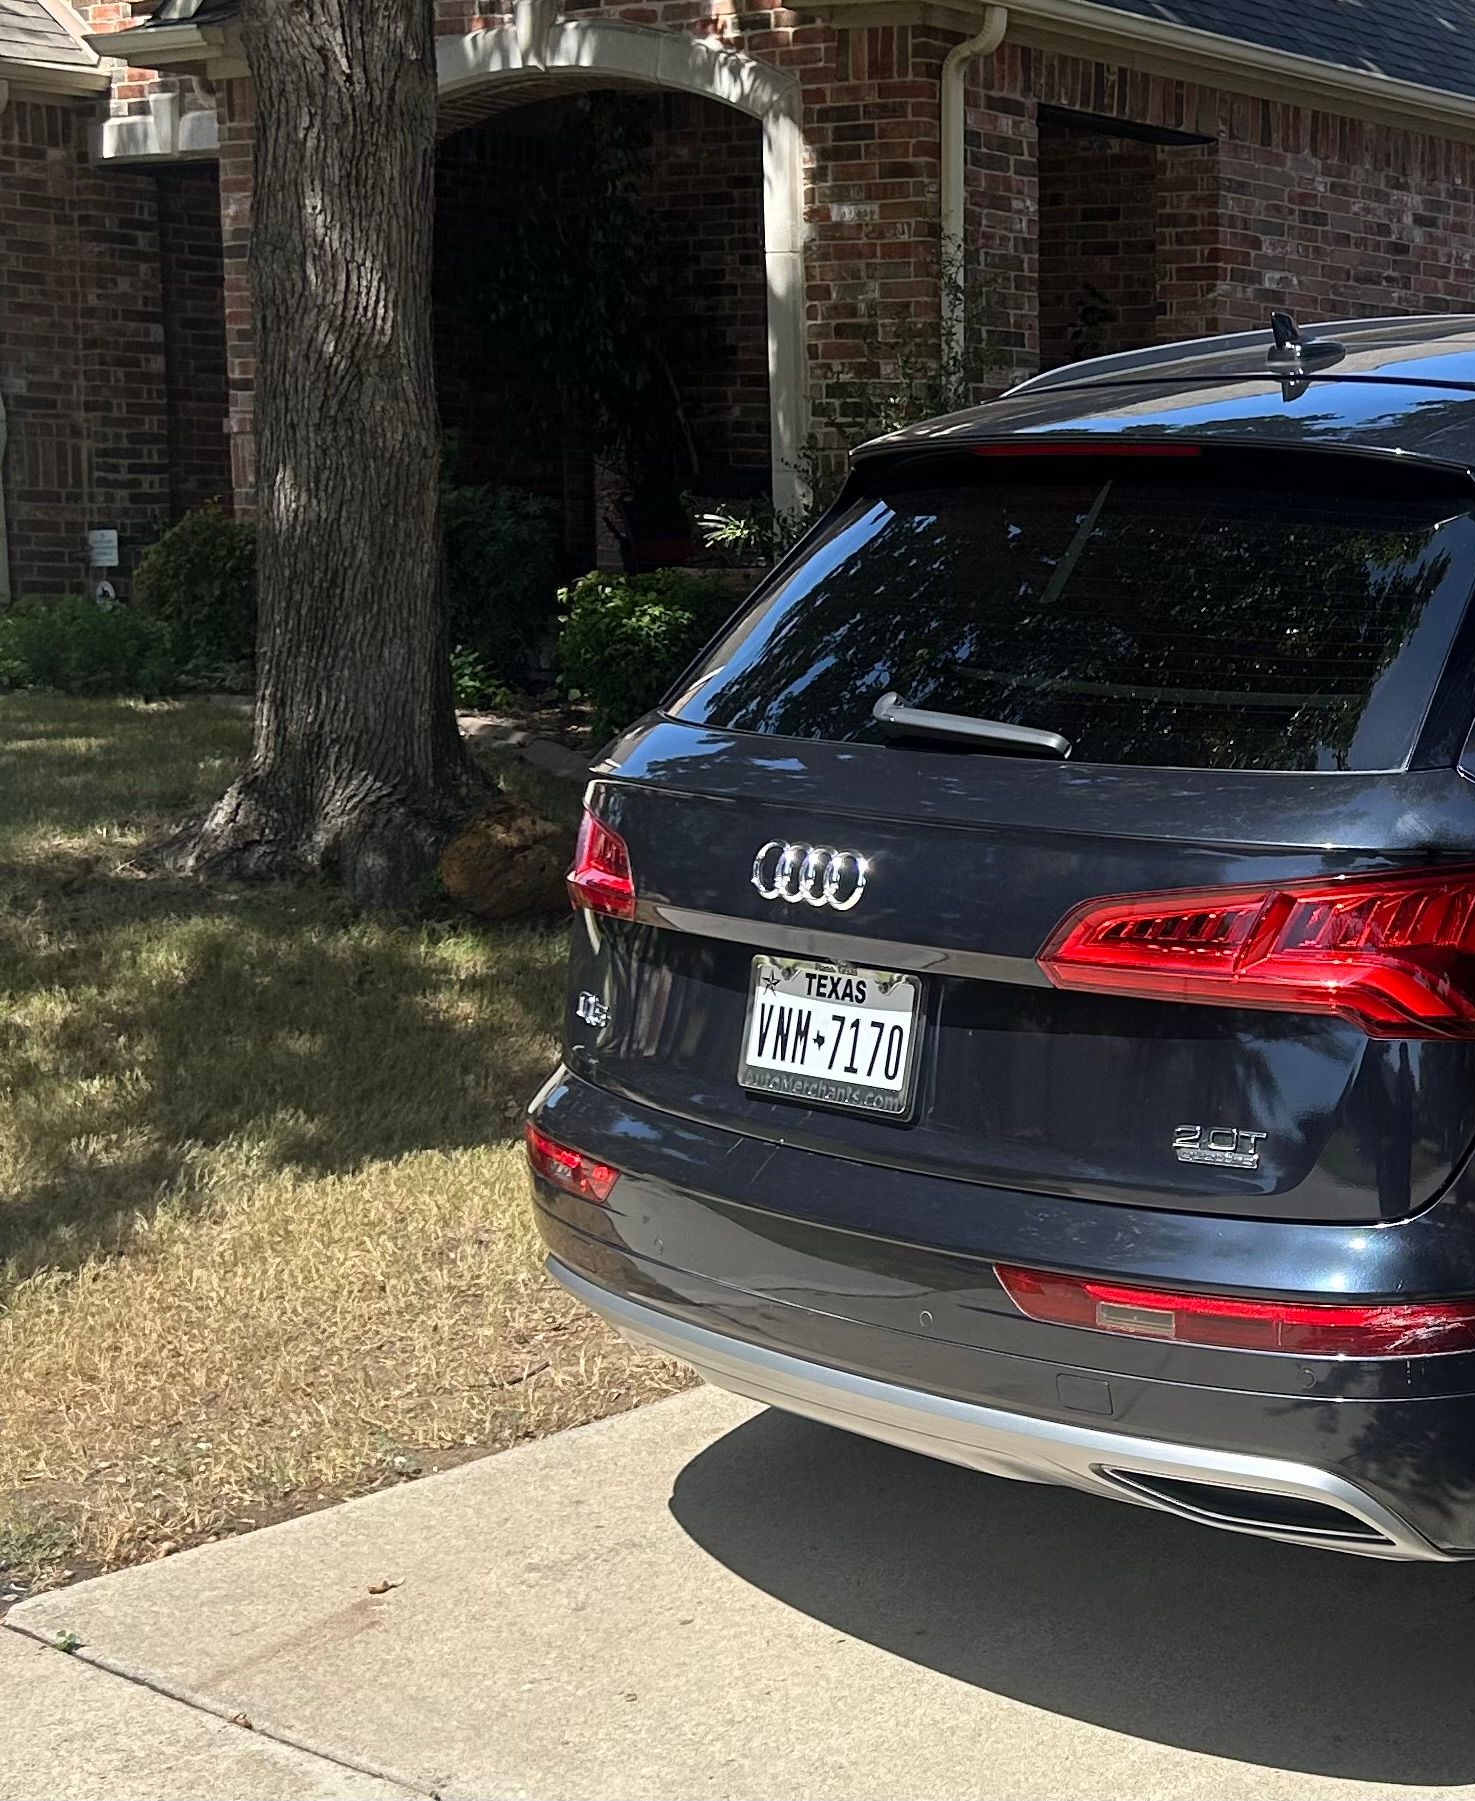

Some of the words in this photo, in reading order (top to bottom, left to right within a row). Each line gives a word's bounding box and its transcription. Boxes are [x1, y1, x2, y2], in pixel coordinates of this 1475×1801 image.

[806, 972, 867, 1004] TEXAS
[757, 1003, 812, 1065] VNM
[827, 1014, 904, 1081] 7170
